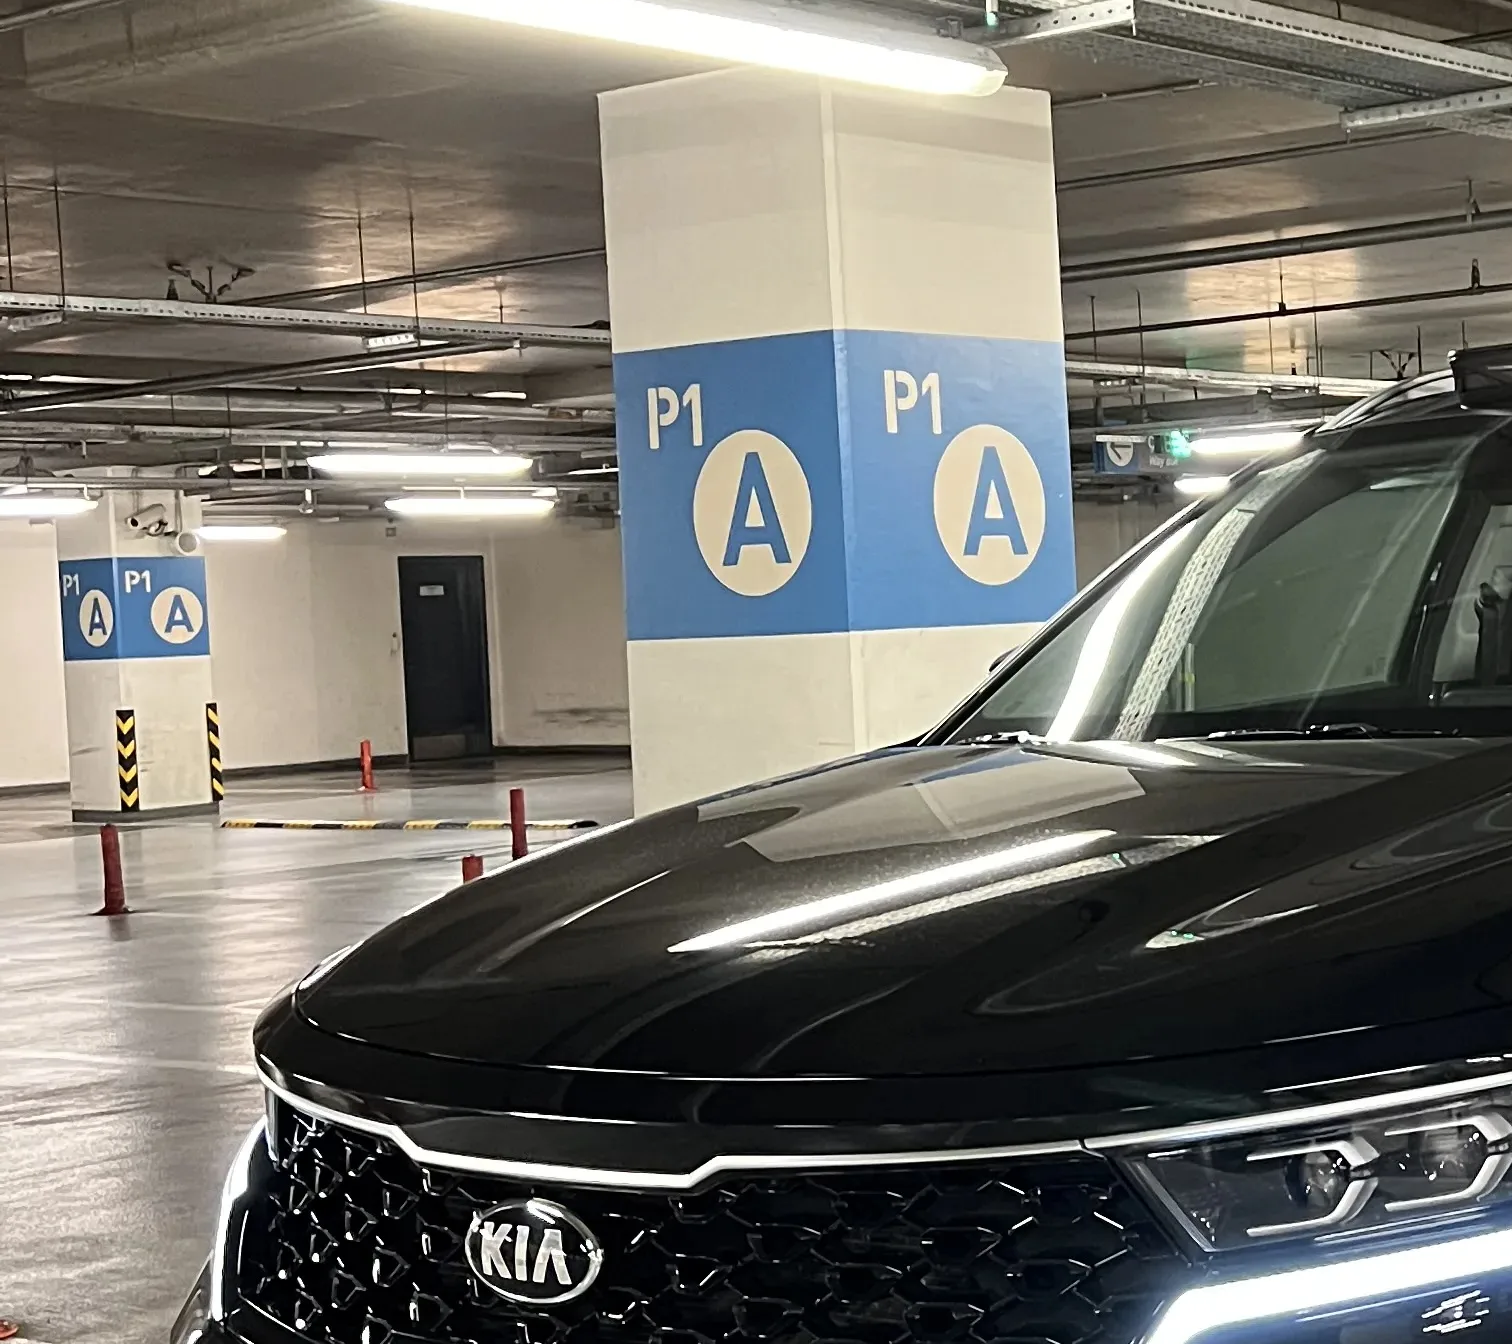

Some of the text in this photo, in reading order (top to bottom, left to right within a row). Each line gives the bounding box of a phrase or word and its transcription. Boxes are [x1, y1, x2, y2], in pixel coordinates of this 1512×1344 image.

[647, 383, 703, 450] P1
[884, 369, 942, 435] P1
[722, 451, 792, 567] A
[964, 445, 1028, 557] A
[62, 573, 81, 597] P1
[124, 570, 151, 594] P1
[164, 594, 194, 634] A
[88, 597, 107, 637] A
[480, 1220, 574, 1286] KIA
